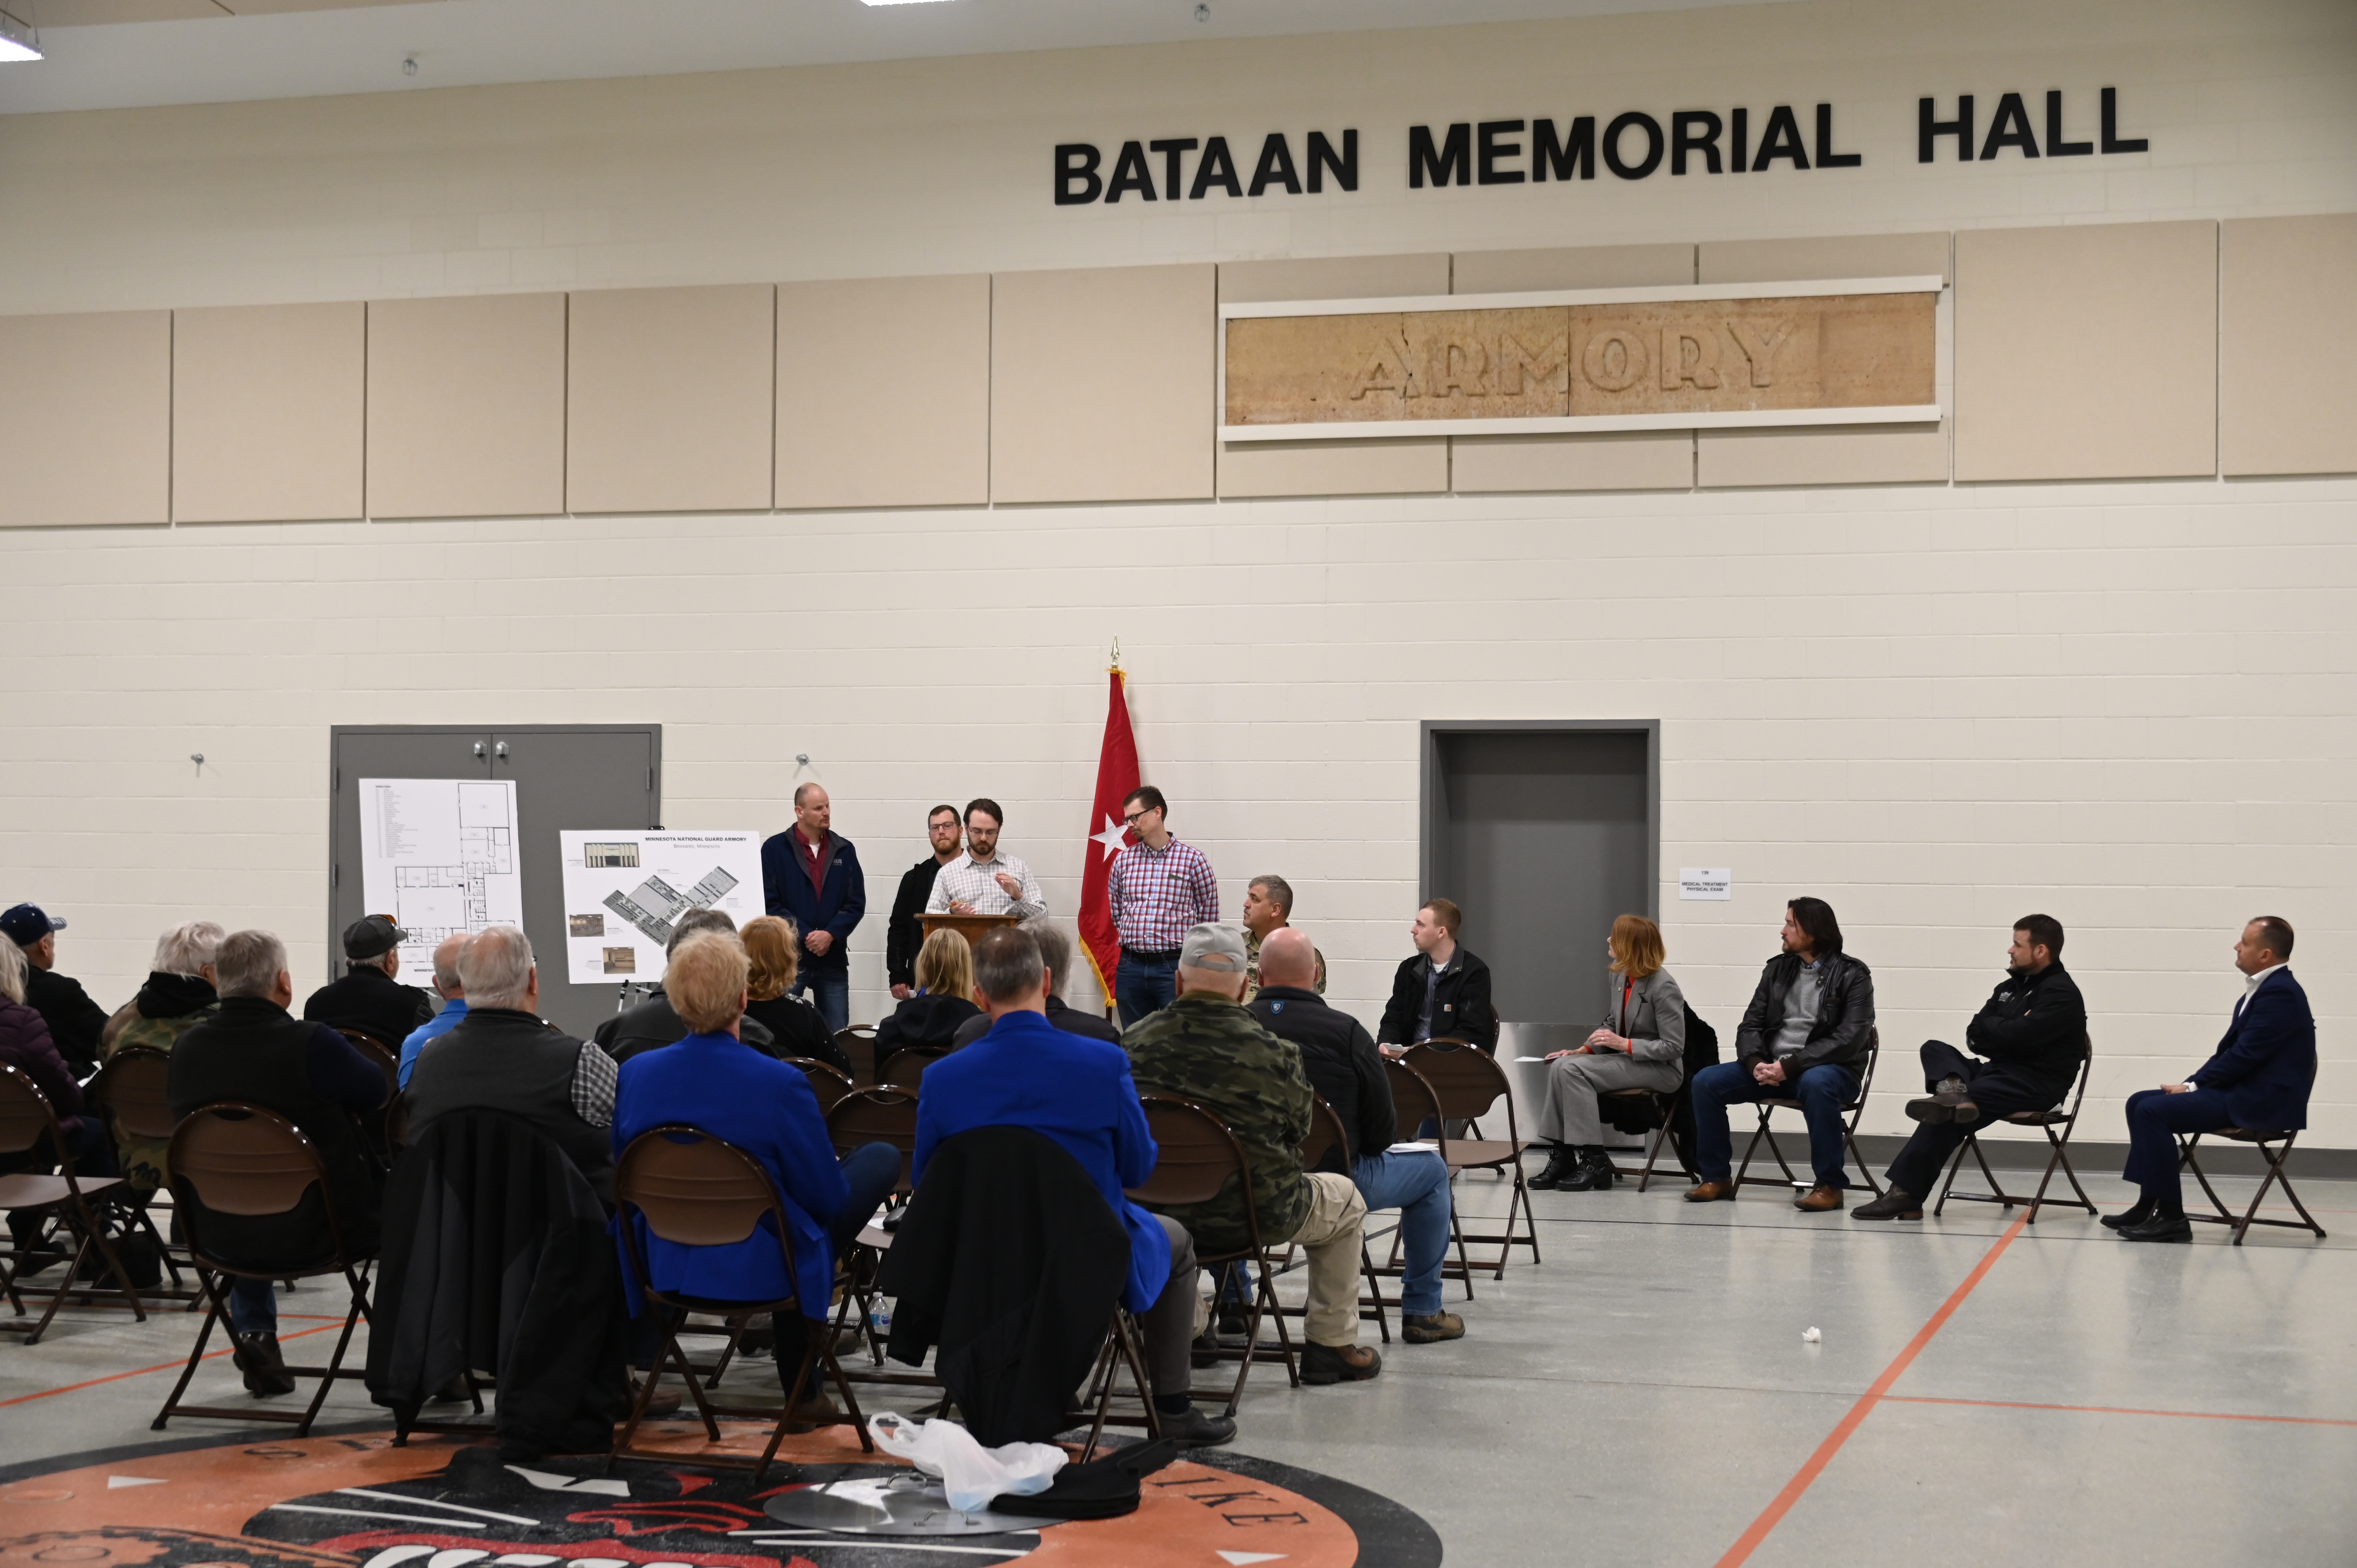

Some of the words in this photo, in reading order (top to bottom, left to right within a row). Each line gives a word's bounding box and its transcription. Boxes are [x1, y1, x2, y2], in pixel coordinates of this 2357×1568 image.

[1054, 129, 1358, 205] BATAAN
[1409, 103, 1862, 189] MEMORIAL
[1918, 87, 2149, 163] HALL
[1349, 319, 1795, 400] ARMORY
